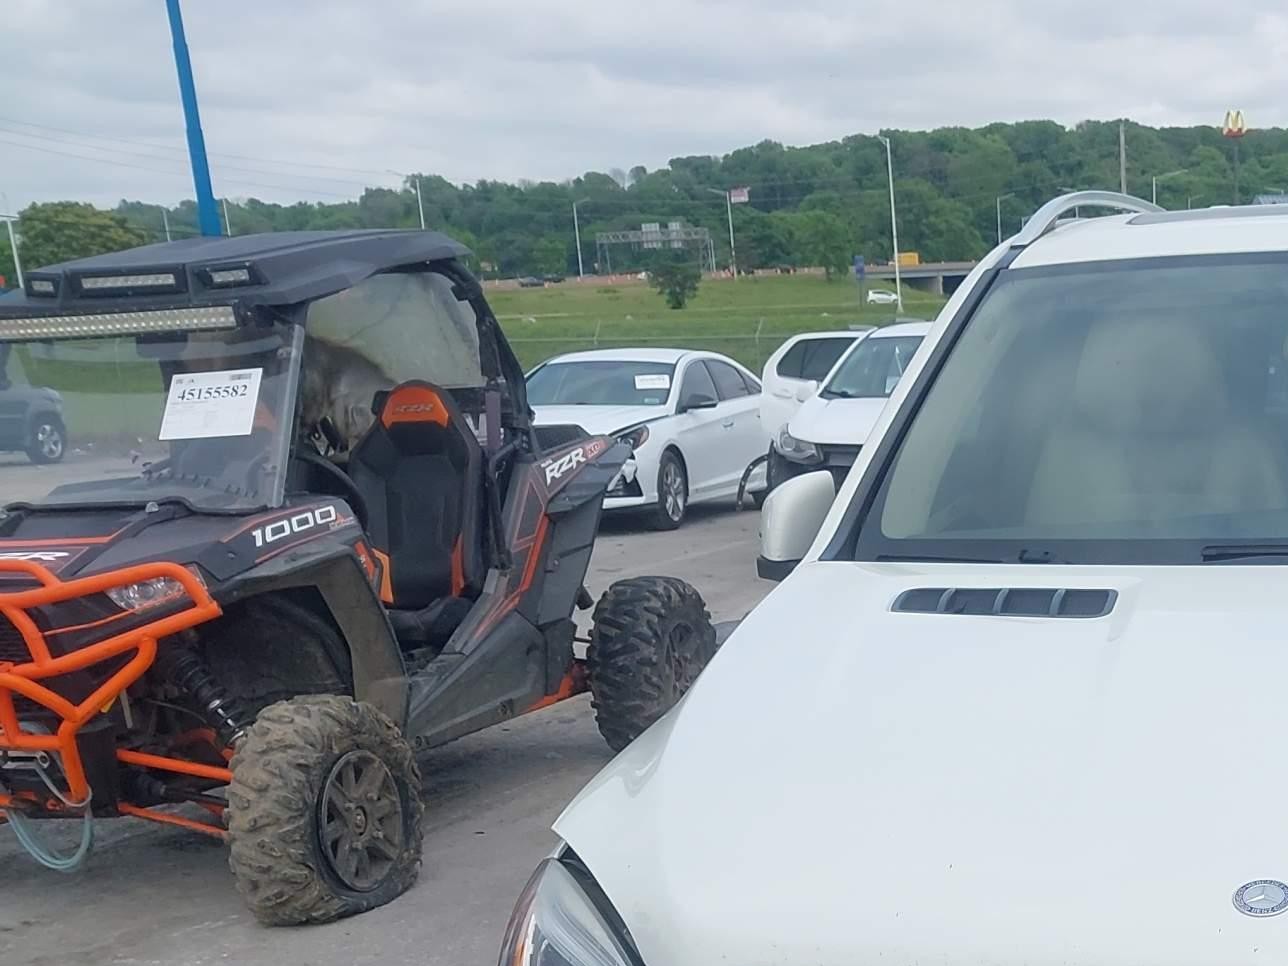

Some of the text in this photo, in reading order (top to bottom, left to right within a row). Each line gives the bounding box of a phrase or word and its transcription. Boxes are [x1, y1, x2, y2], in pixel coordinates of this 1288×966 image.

[177, 384, 248, 401] 45155582
[544, 447, 586, 487] RZR
[252, 505, 336, 547] 1000
